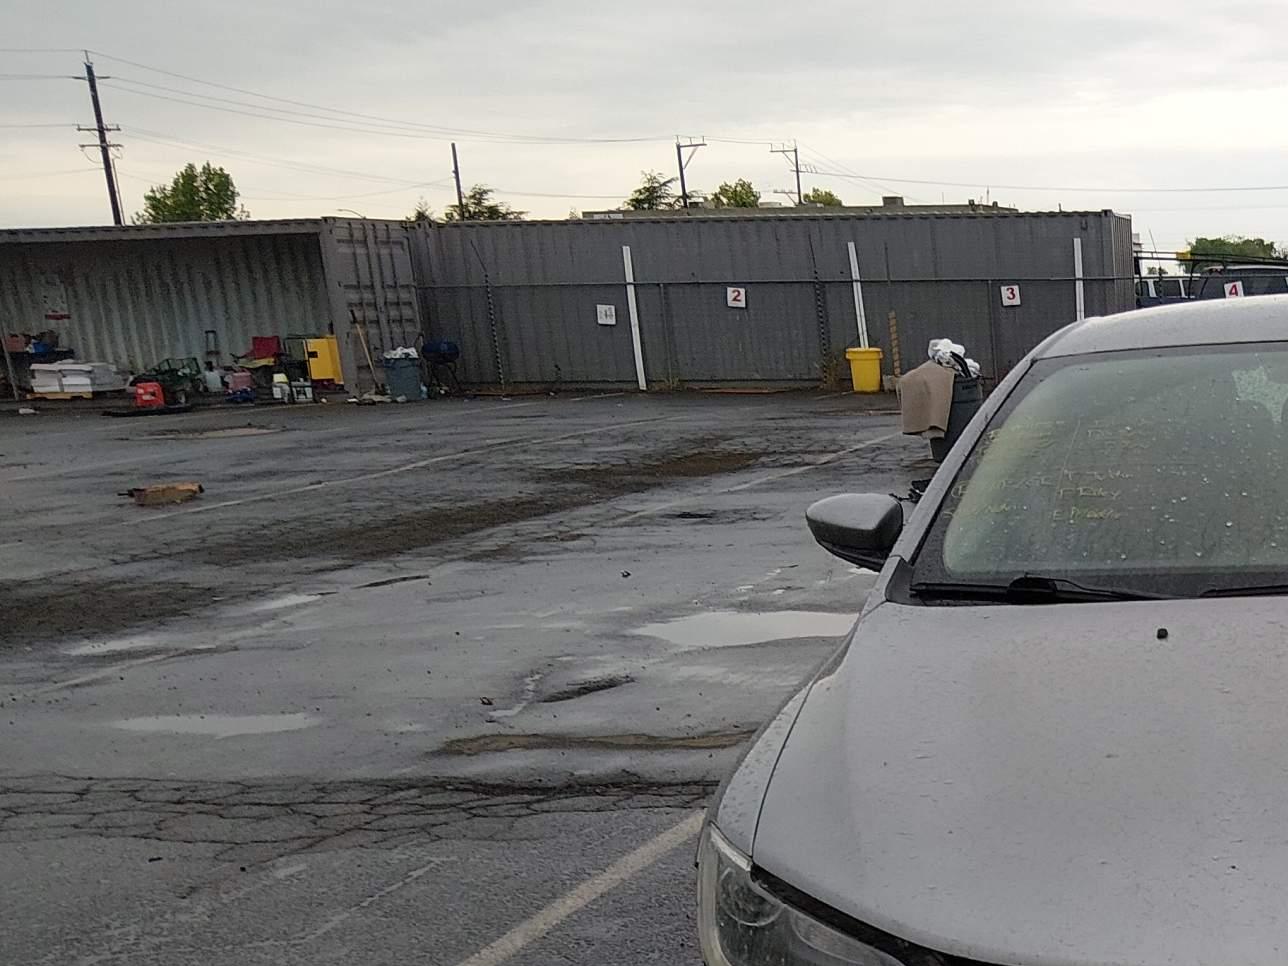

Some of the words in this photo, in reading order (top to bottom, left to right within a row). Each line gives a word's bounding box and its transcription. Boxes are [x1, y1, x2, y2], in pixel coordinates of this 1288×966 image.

[732, 289, 742, 302] 2
[1007, 288, 1016, 301] 3
[1229, 284, 1239, 297] 4
